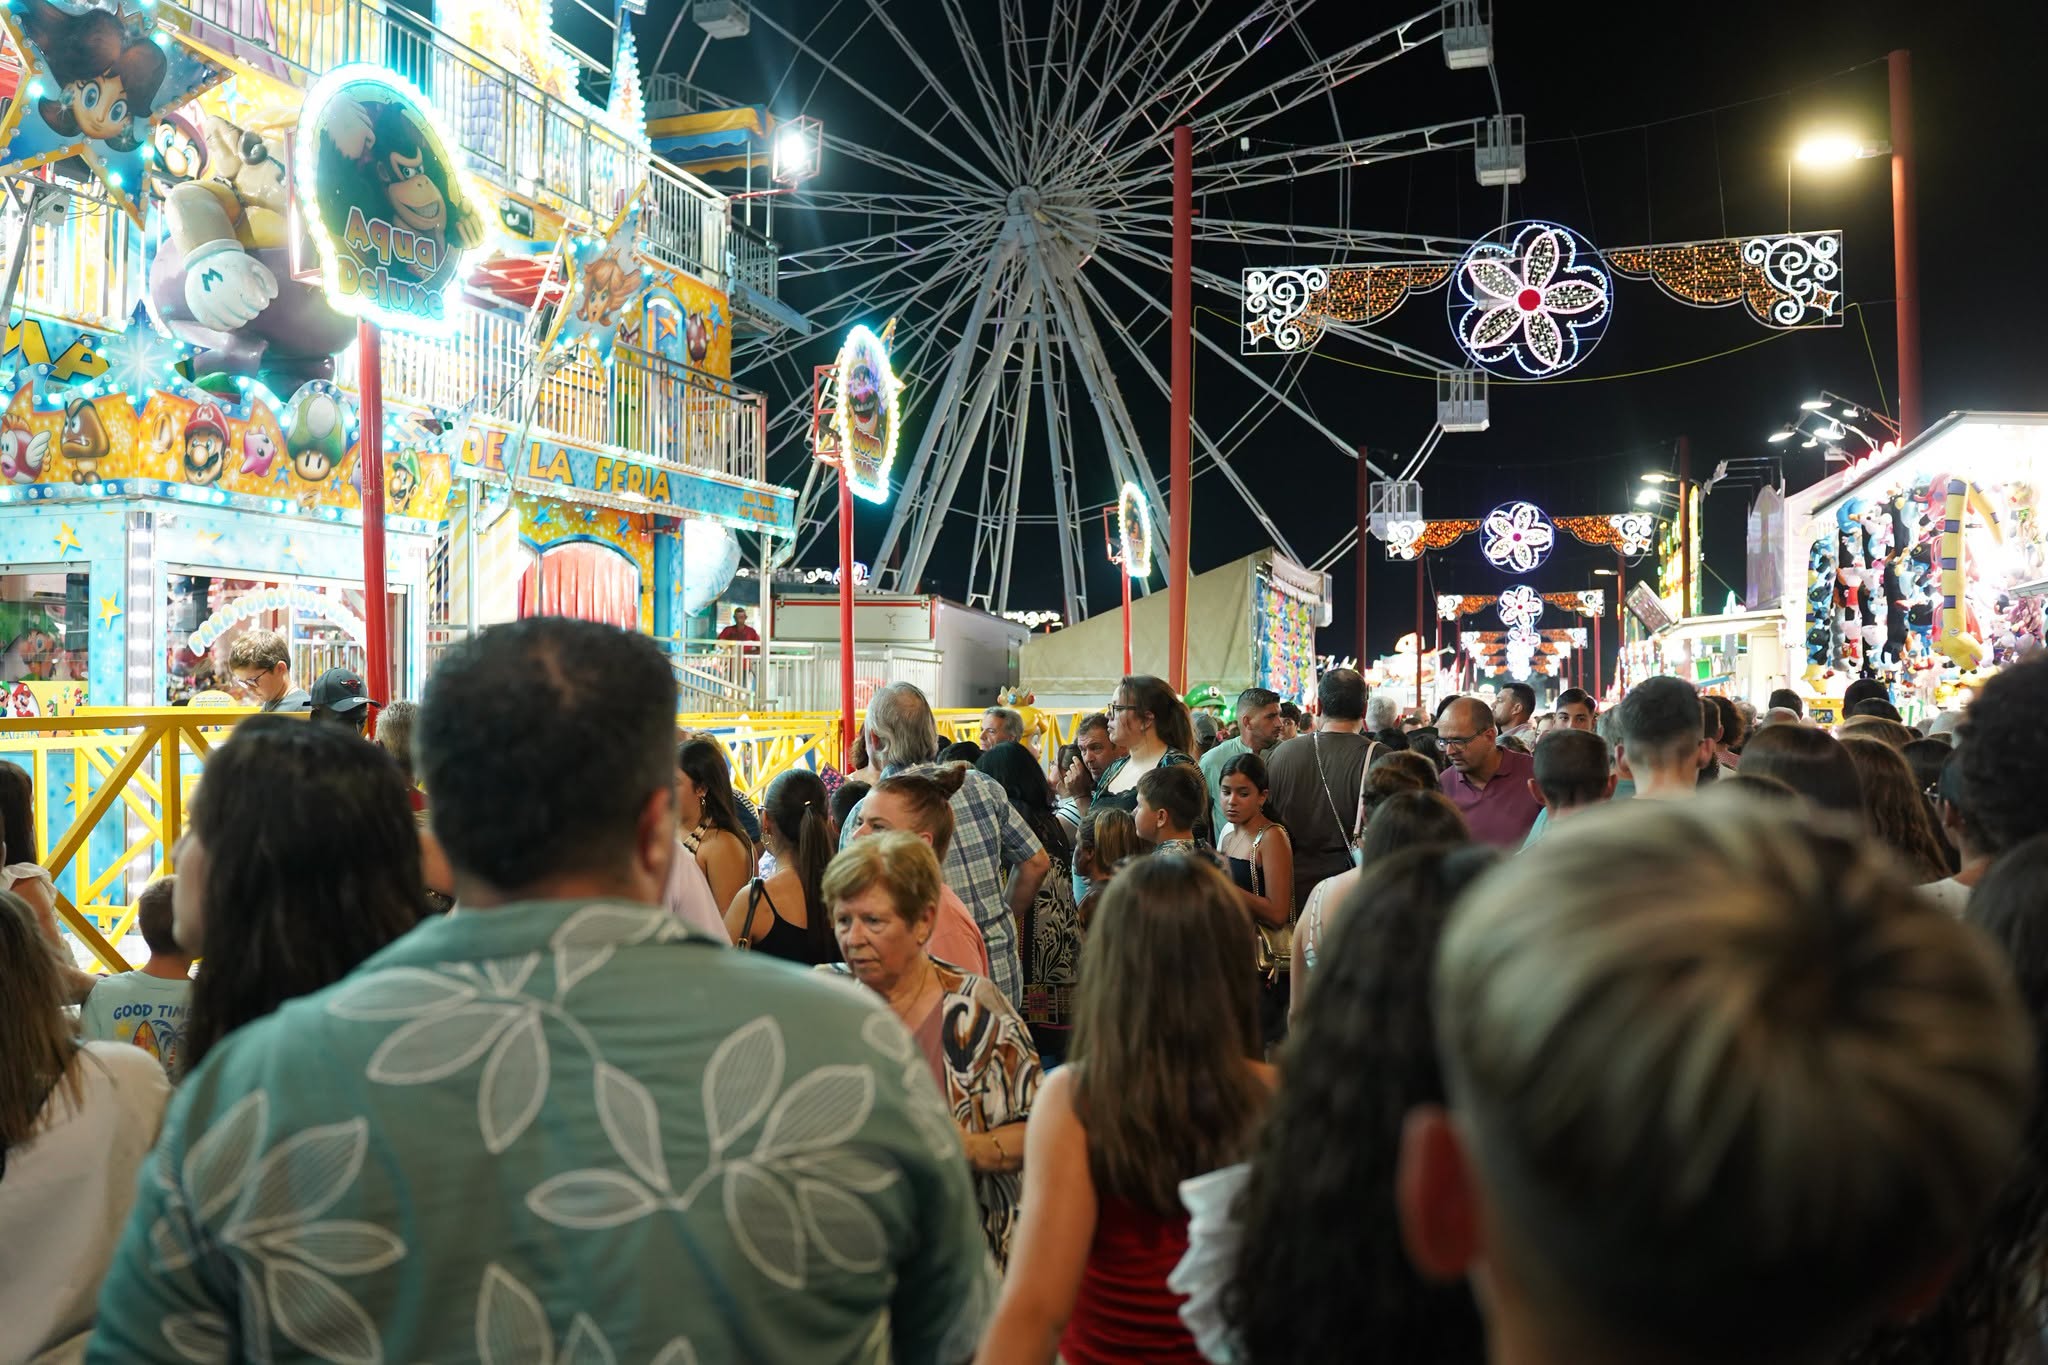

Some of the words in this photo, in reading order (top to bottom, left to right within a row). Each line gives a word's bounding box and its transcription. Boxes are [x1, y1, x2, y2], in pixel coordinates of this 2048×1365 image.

[344, 206, 437, 272] Aqua
[337, 256, 445, 321] Deluxe
[461, 426, 507, 471] DE
[528, 442, 574, 486] LA
[594, 456, 671, 504] FERIA
[113, 1003, 153, 1020] GOOD
